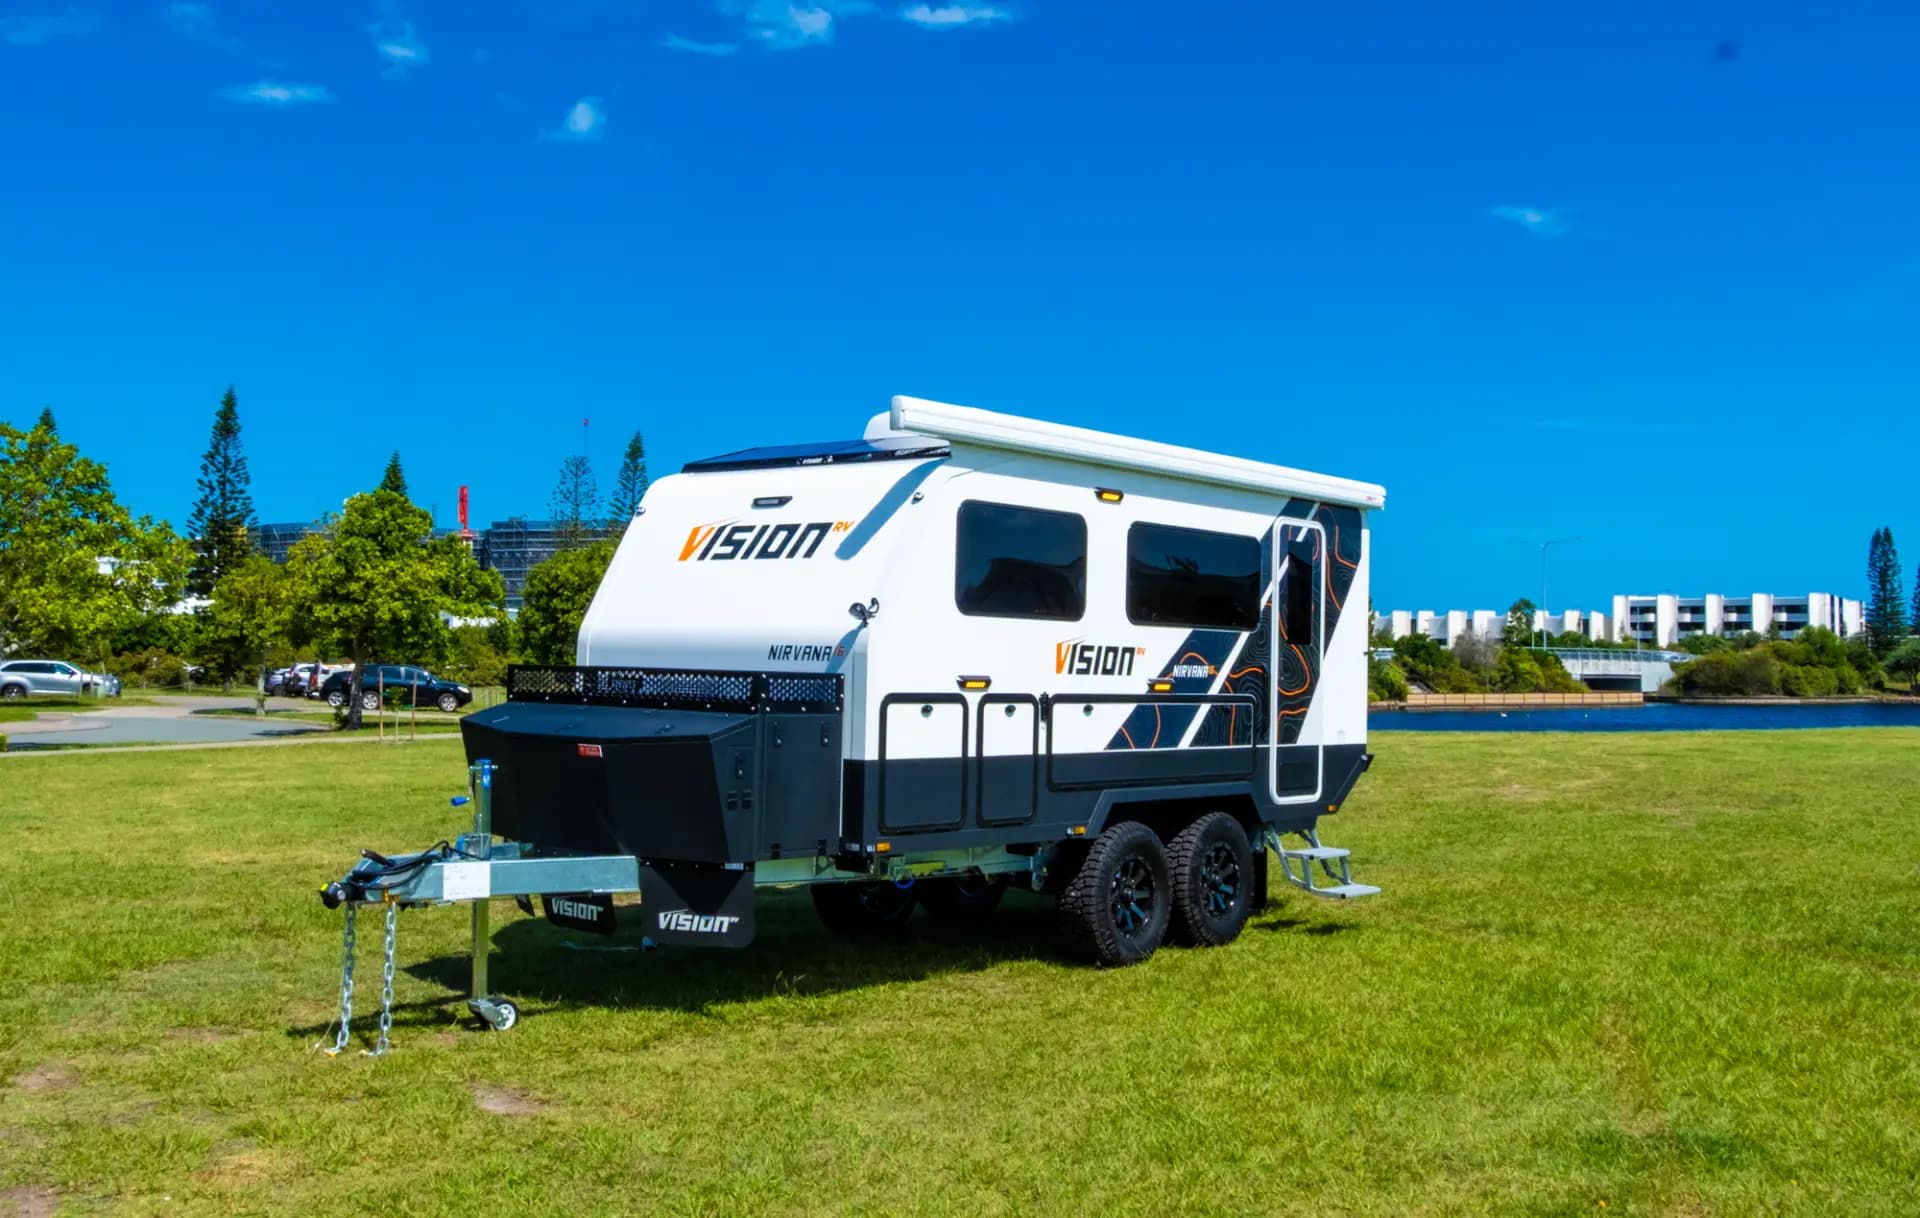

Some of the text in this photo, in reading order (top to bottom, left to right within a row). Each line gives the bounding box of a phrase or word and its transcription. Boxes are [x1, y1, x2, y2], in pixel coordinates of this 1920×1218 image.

[678, 520, 855, 561] VISION RV
[767, 644, 833, 662] NIRVANA
[1056, 640, 1136, 676] VISION
[1173, 664, 1209, 679] NIRVANA
[551, 897, 598, 921] VISION
[658, 909, 730, 933] VISION
